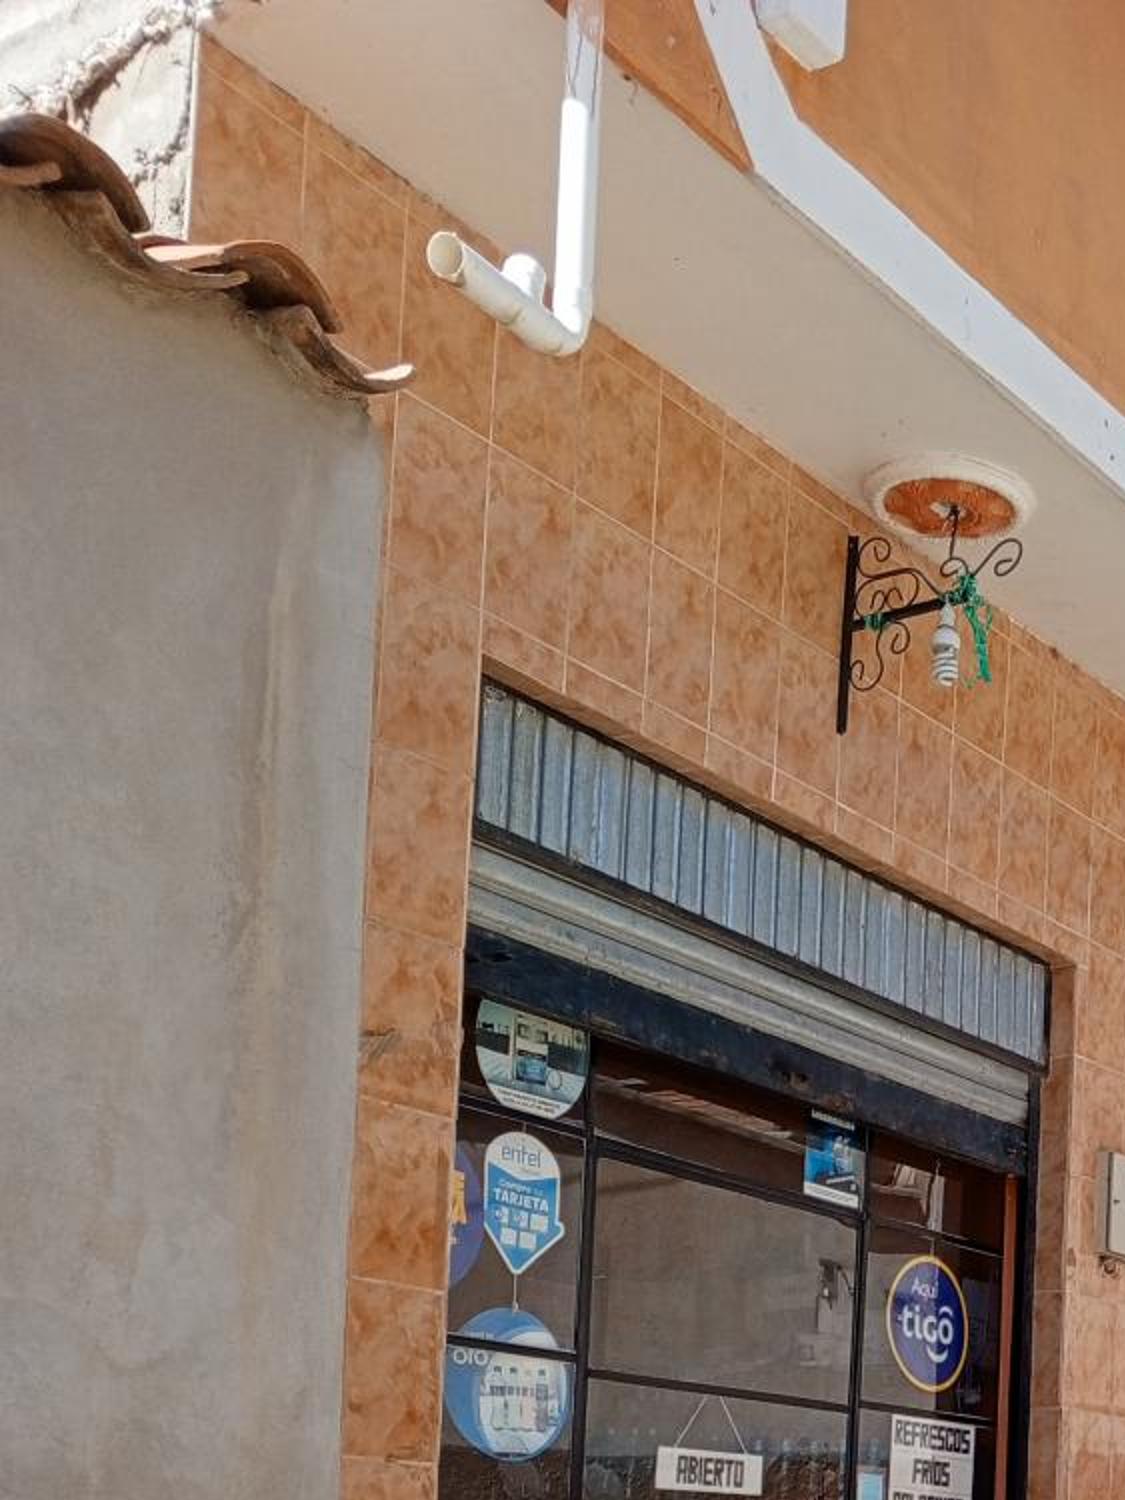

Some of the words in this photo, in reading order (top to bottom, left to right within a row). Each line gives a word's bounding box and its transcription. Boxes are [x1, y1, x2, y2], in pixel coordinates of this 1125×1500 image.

[502, 1144, 541, 1168] entel
[493, 1187, 549, 1212] TARJETA
[898, 1305, 953, 1362] tigo
[894, 1420, 971, 1454] REFRESCOS
[676, 1455, 744, 1488] ABIERTO
